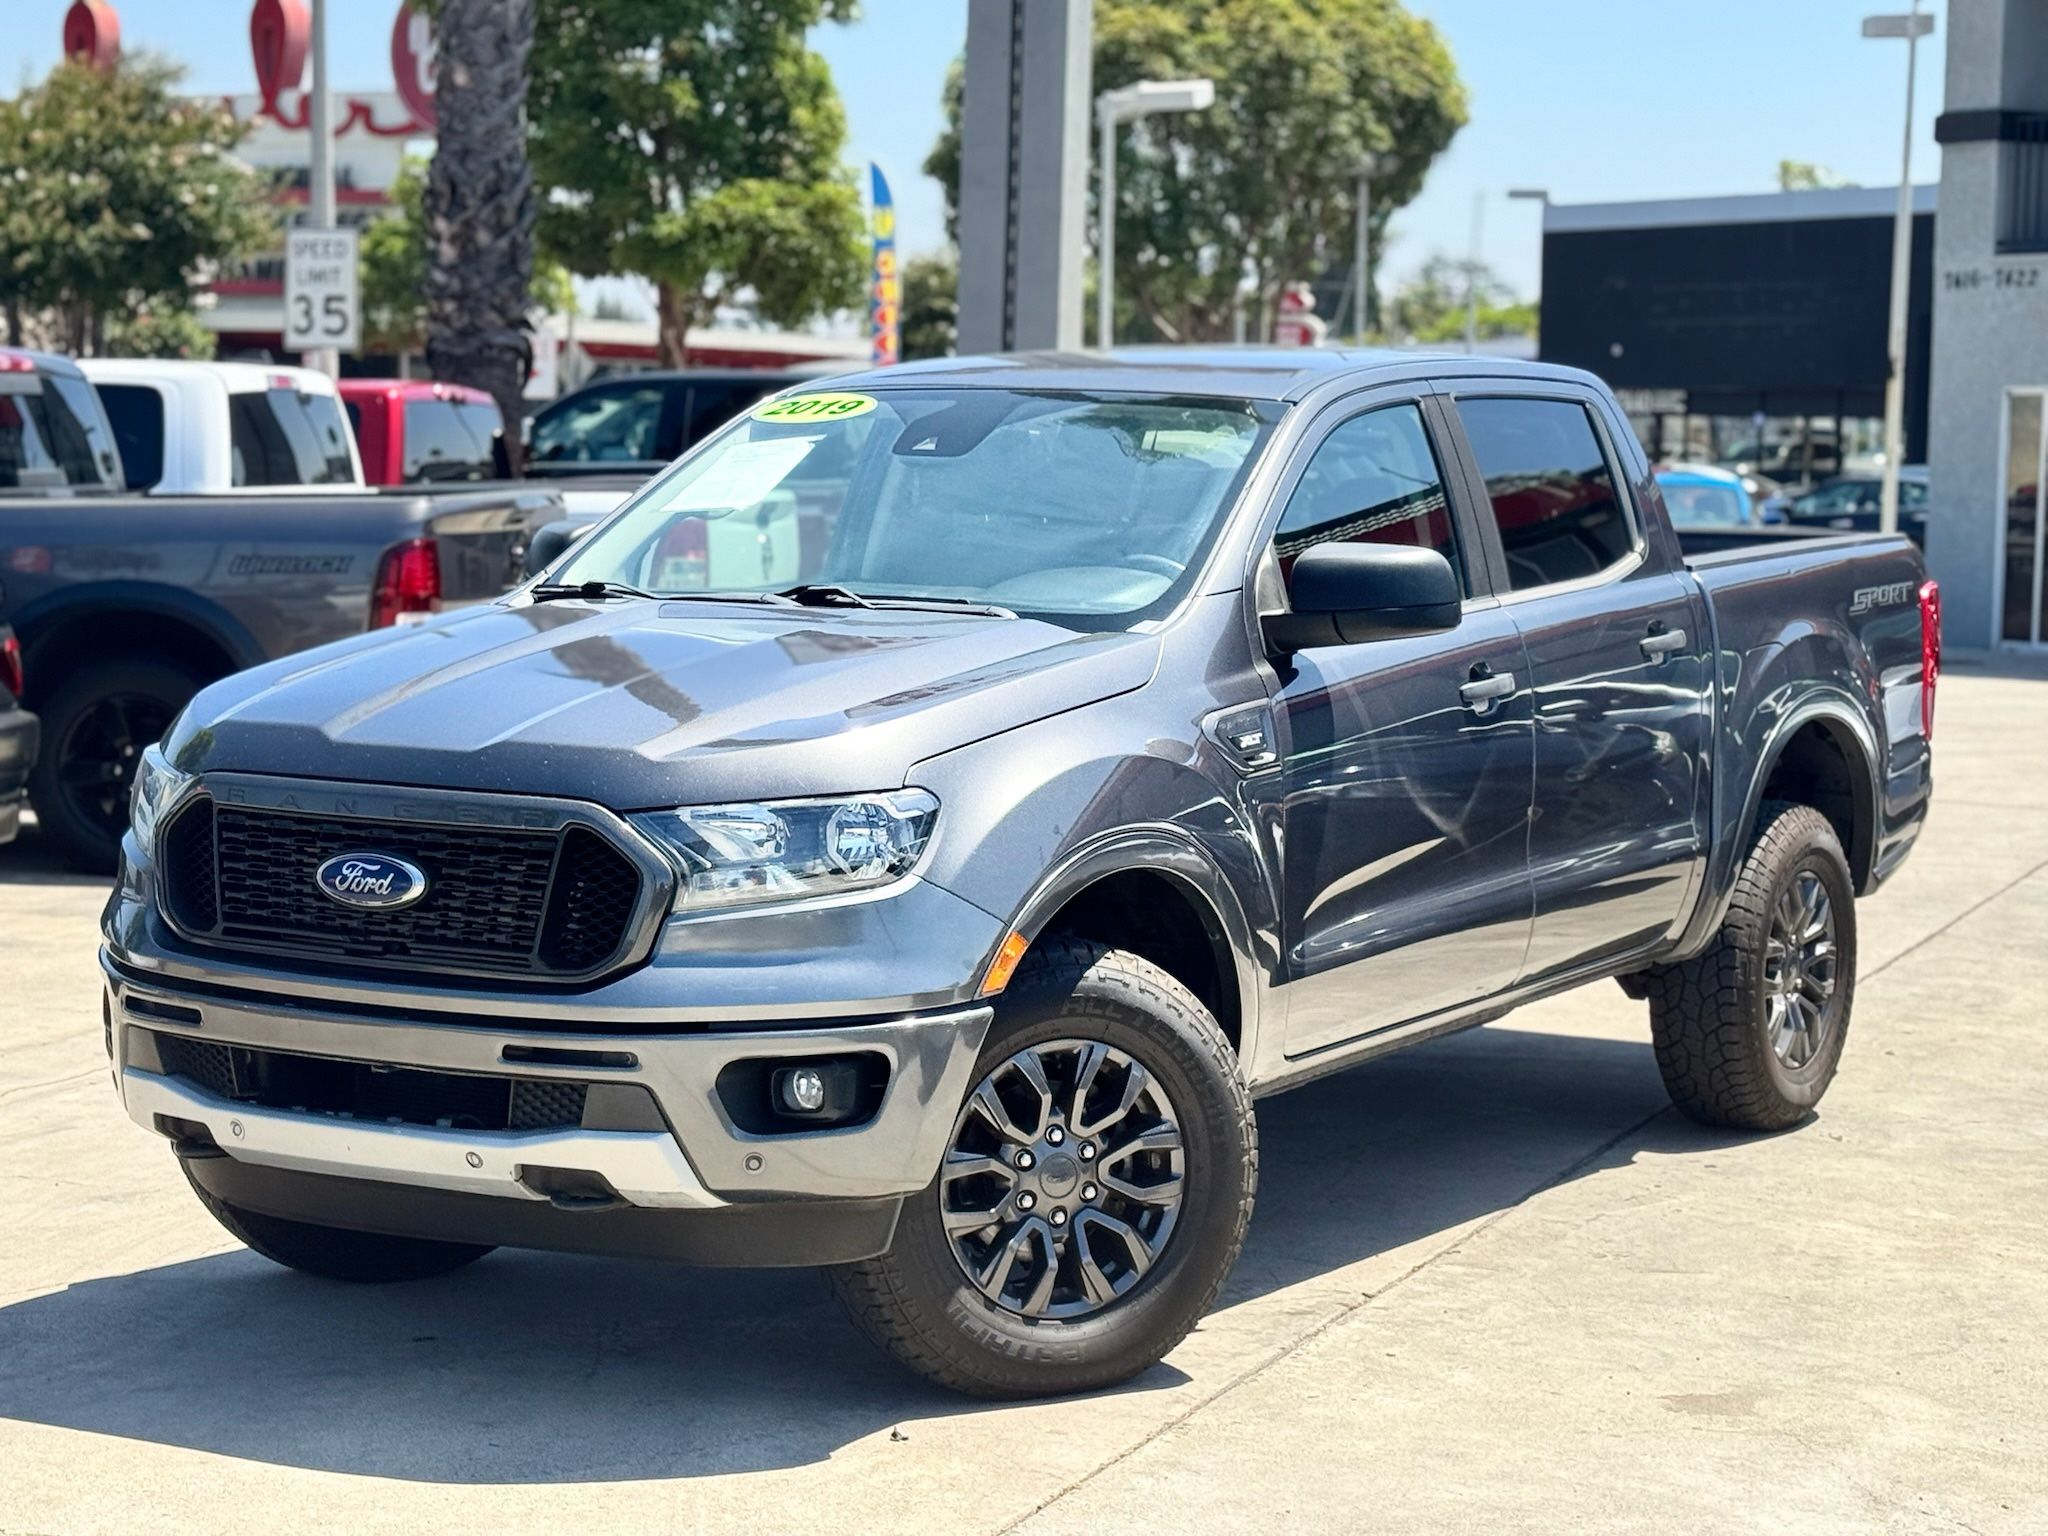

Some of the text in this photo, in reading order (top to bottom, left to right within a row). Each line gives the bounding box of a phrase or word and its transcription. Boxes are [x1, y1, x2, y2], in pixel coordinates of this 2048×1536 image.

[293, 240, 349, 260] SPEED
[295, 266, 341, 286] LIMIT
[293, 294, 349, 336] 35
[761, 400, 865, 417] 2019
[1848, 581, 1914, 616] SPORT
[227, 786, 556, 829] RANGER
[334, 860, 395, 896] Ford
